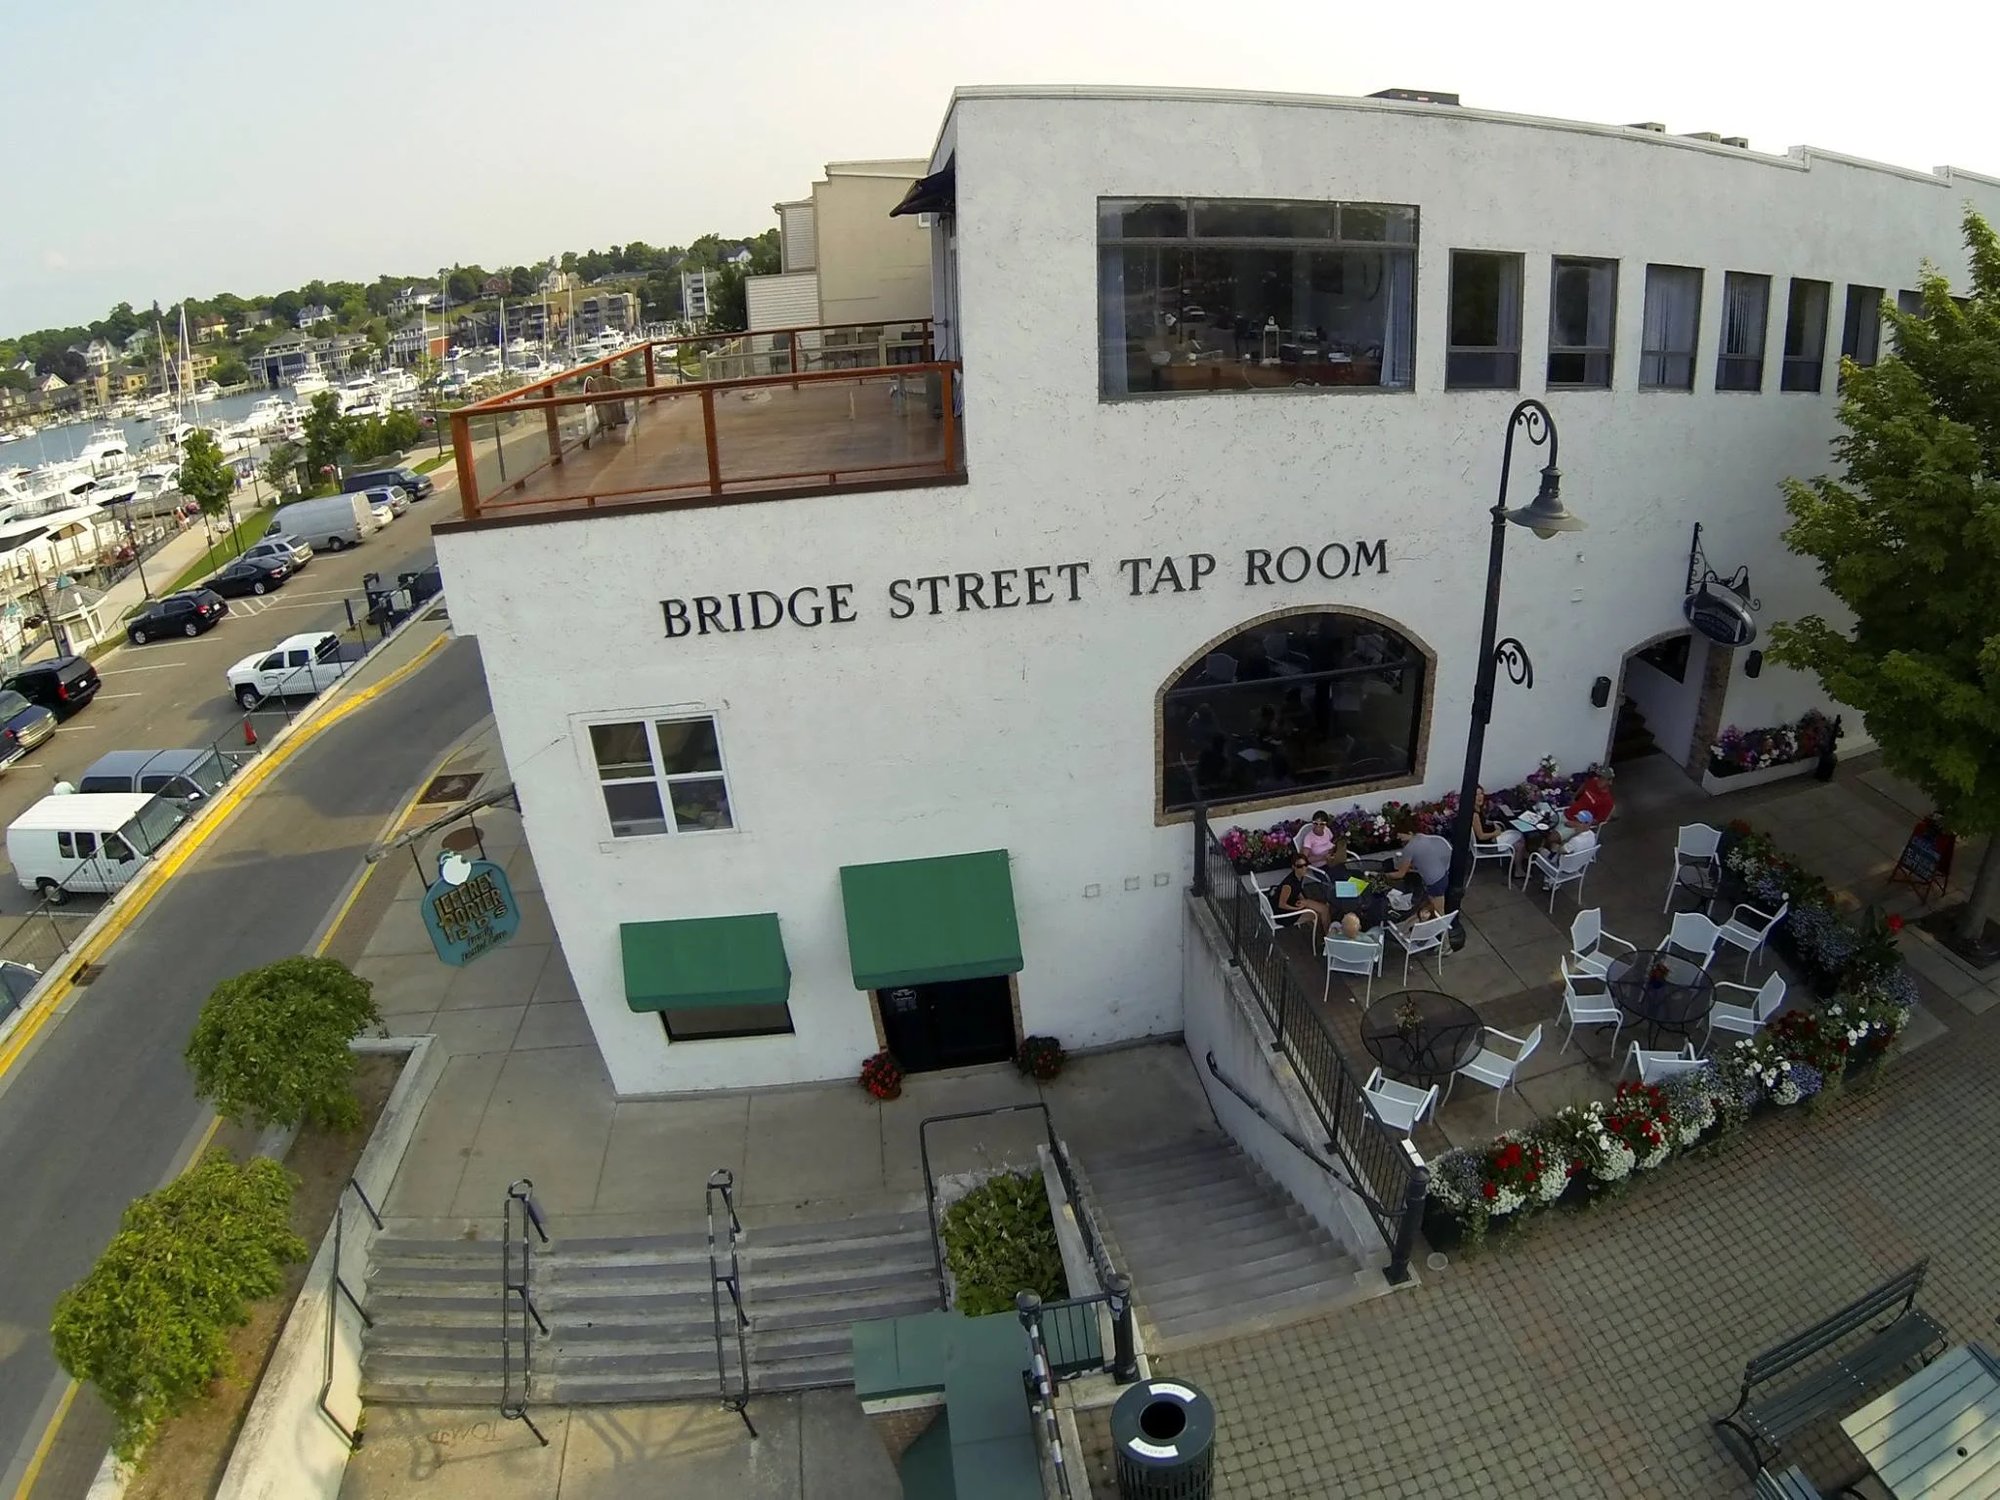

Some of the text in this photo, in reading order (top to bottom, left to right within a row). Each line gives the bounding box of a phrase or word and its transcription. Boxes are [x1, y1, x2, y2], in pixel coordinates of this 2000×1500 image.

[660, 538, 1390, 639] BRIDGE STREET TAP ROOM
[433, 869, 494, 916] JEFFREY
[437, 888, 504, 945] PORTER
